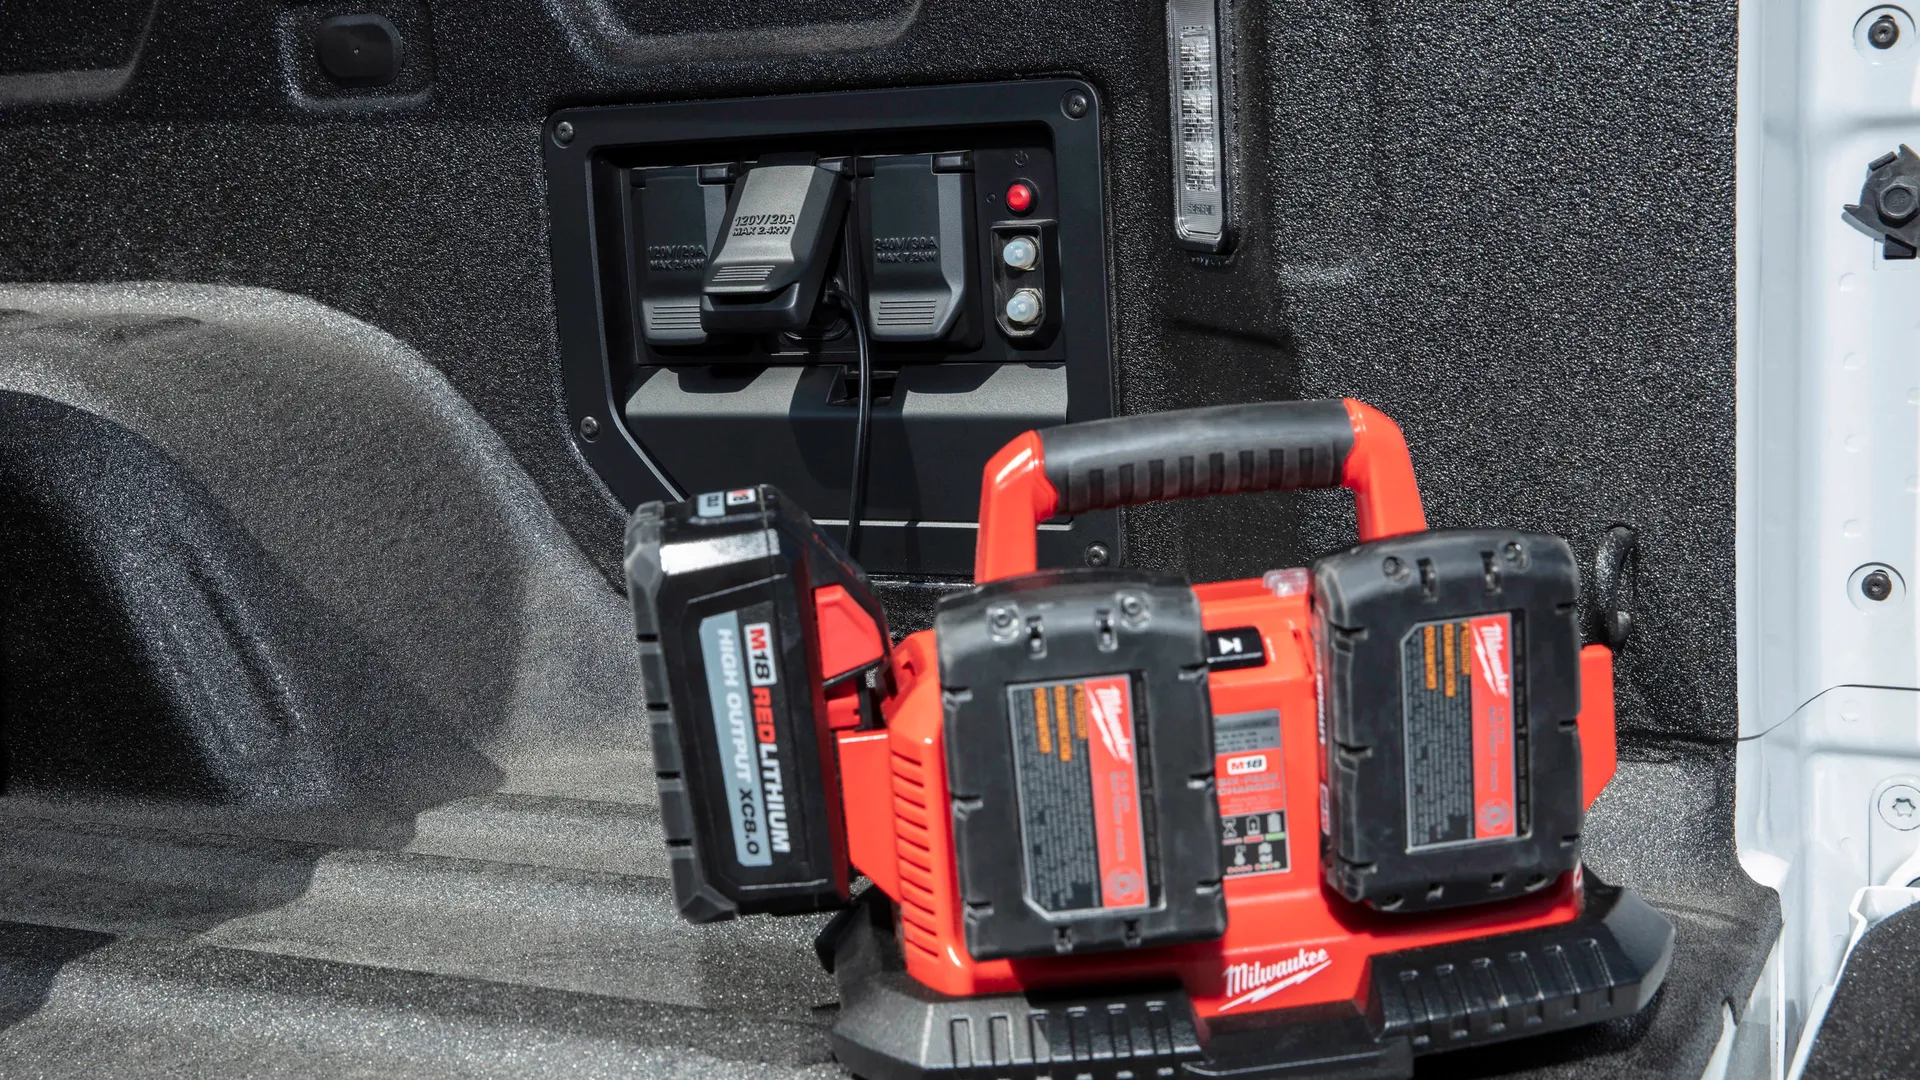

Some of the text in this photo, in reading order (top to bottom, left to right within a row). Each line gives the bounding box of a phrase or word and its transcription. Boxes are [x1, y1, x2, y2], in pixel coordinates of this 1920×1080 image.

[735, 214, 796, 227] 120V/20A
[732, 227, 757, 237] MAX
[874, 236, 939, 251] 240V/30A
[877, 252, 902, 264] MAX
[749, 627, 772, 680] M18
[717, 627, 760, 856] HIGH OUTPUT XC8.0
[1221, 948, 1329, 998] Milwaukee
